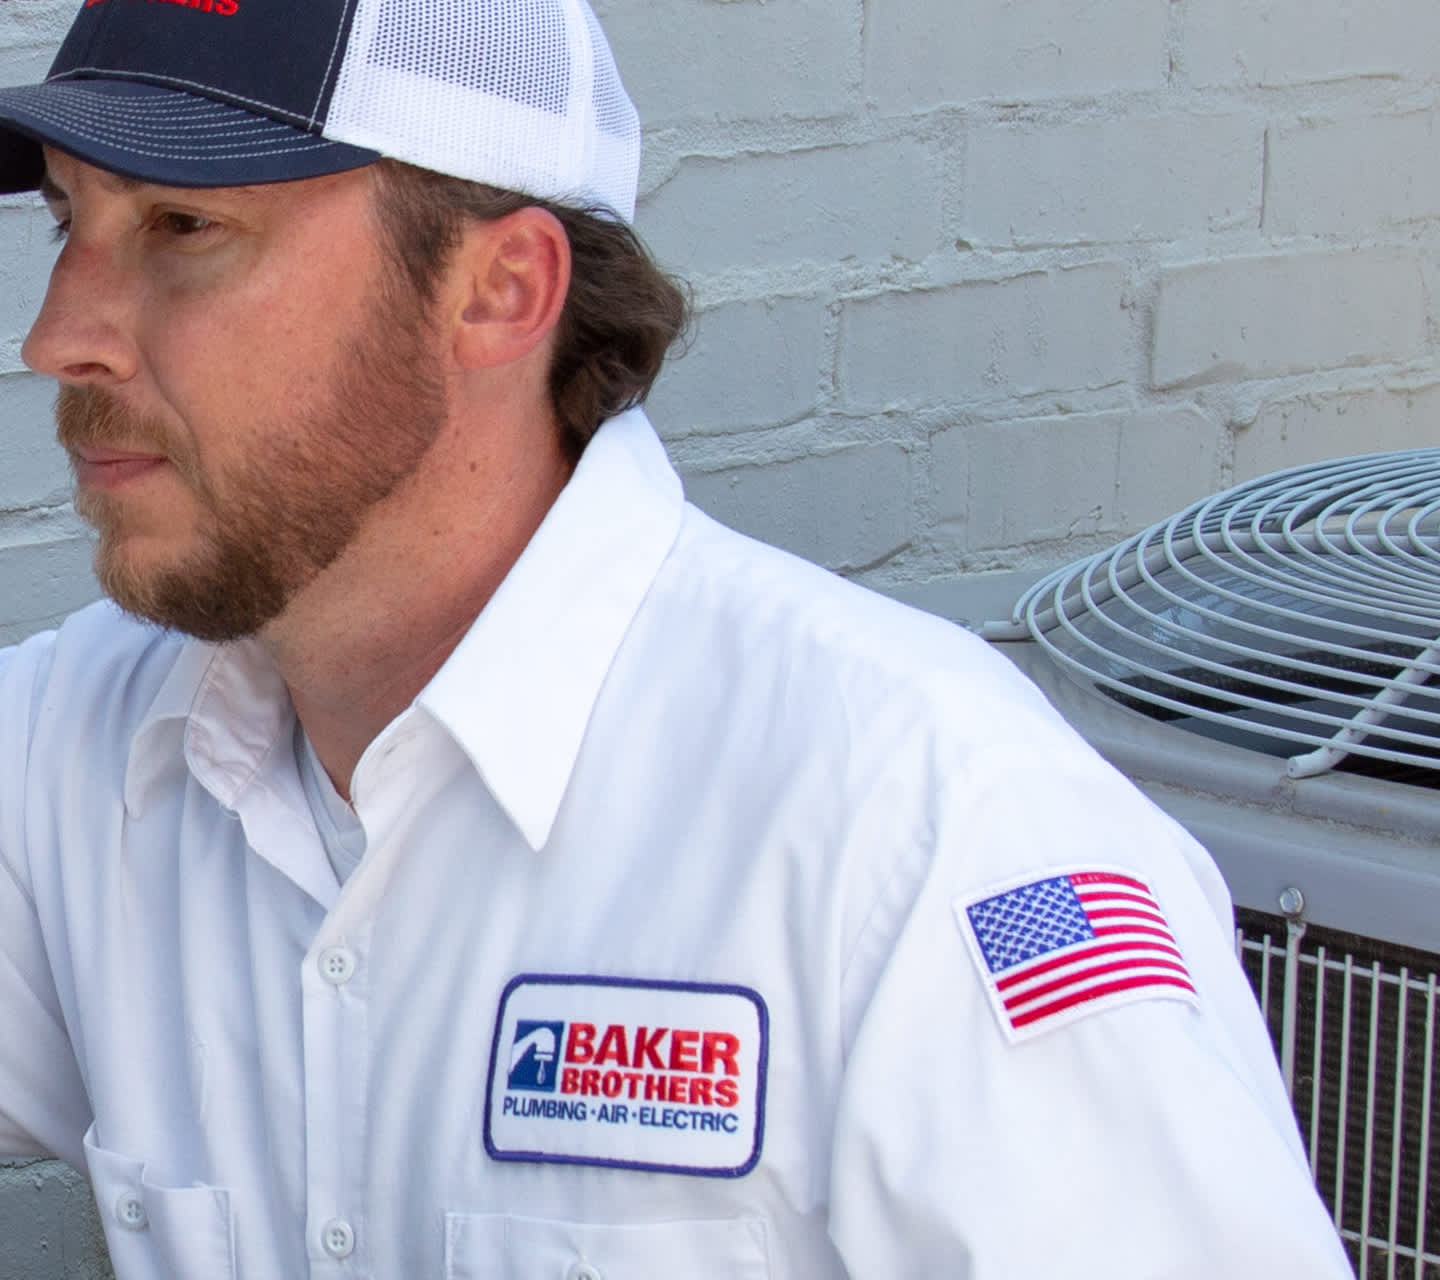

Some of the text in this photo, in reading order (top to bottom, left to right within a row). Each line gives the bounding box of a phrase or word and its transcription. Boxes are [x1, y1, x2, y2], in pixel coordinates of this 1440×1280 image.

[564, 1022, 740, 1076] BAKER
[560, 1067, 739, 1107] BROTHERS
[503, 1096, 738, 1133] PLUMBING AIR ELECTRIC
